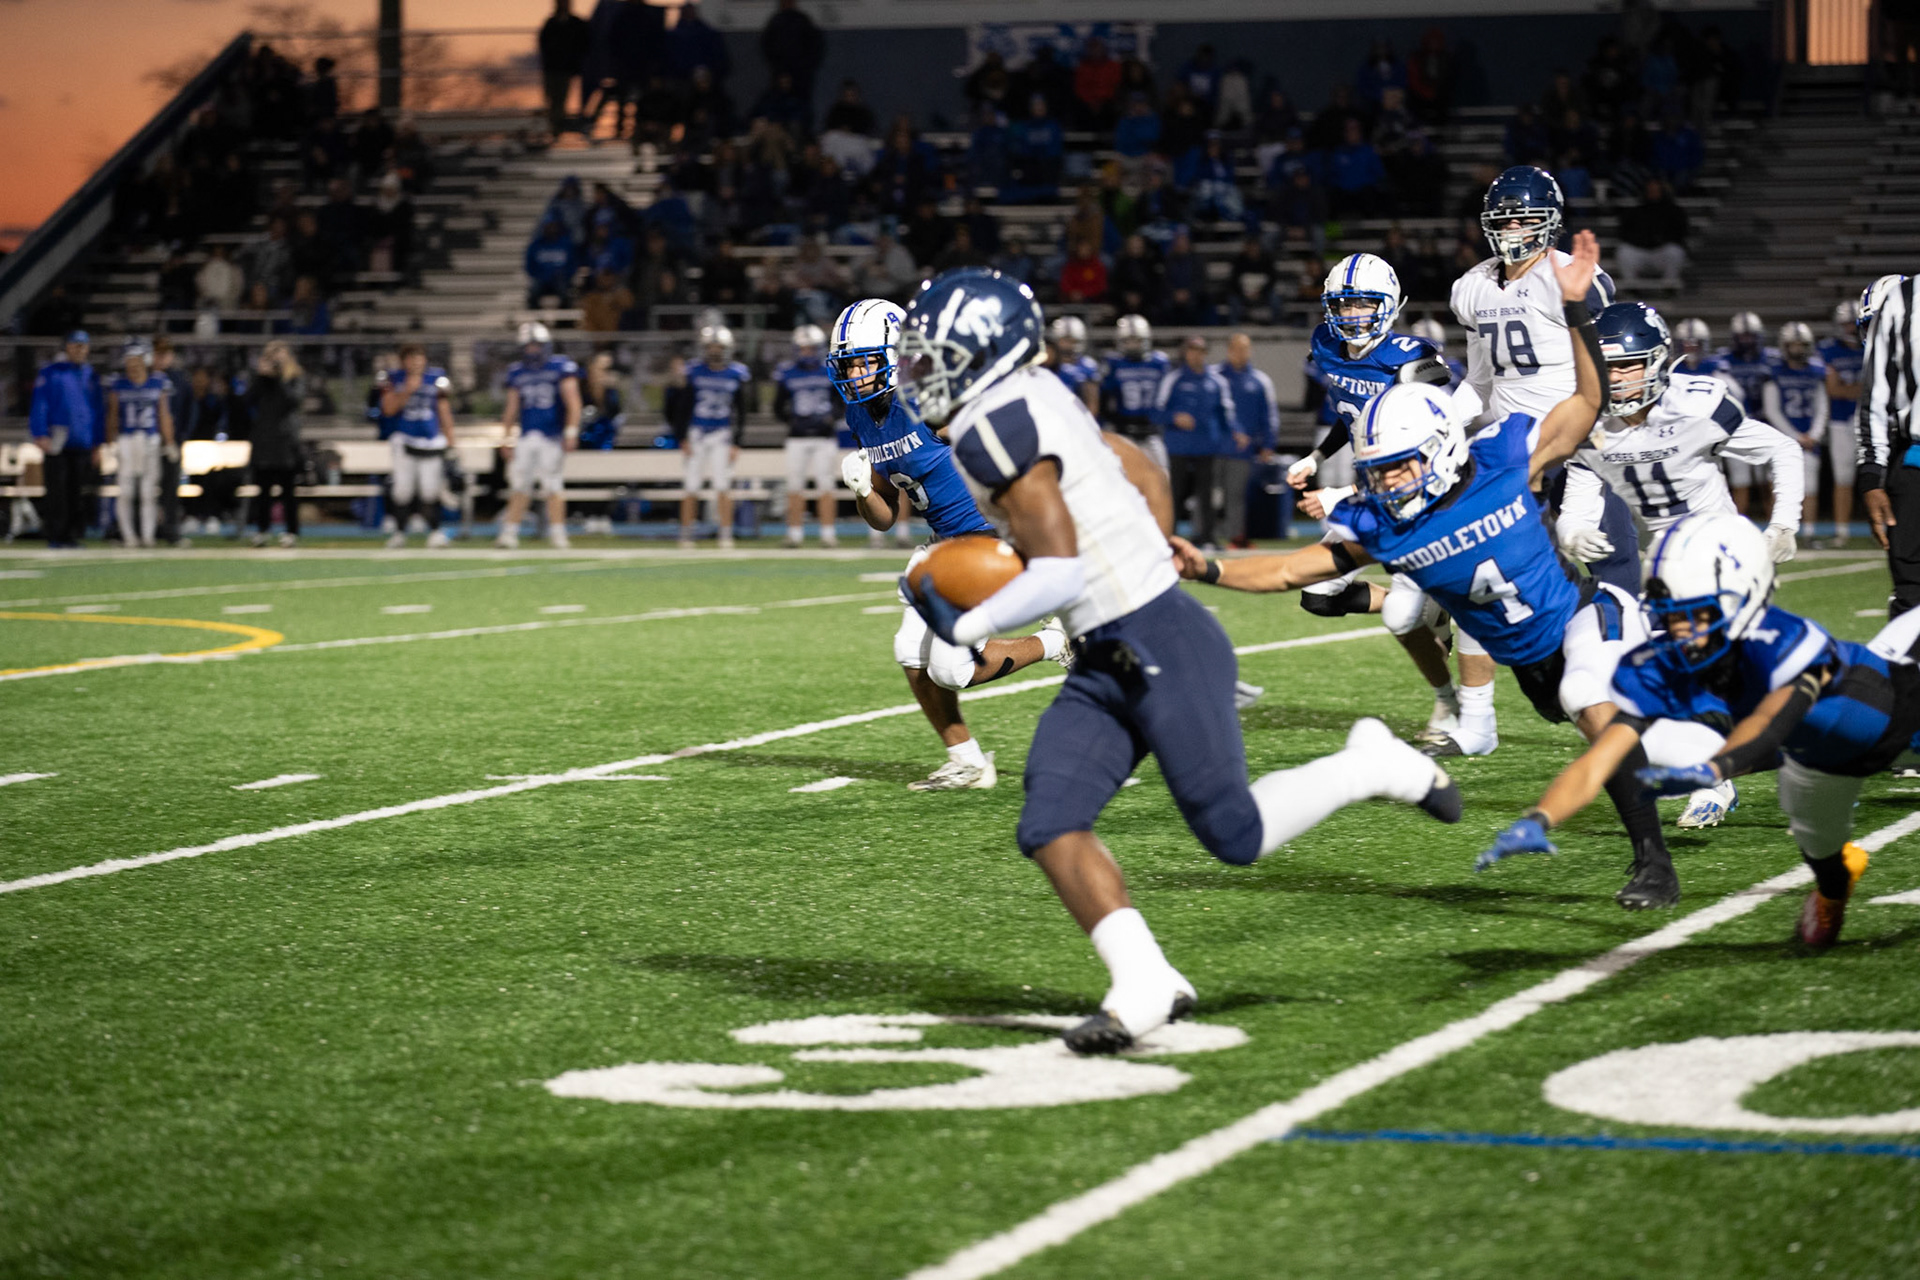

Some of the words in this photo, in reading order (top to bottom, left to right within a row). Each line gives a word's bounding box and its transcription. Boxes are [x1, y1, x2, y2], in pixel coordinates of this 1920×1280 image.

[1475, 309, 1498, 319] MOSES
[1500, 306, 1527, 317] BROWN
[1391, 336, 1421, 353] 2
[1478, 320, 1541, 377] 78
[1424, 397, 1447, 420] 4
[1601, 452, 1635, 463] MOSES
[1639, 445, 1679, 461] BROWN
[1623, 461, 1690, 517] 11
[1389, 494, 1528, 571] MIDDLETOWN
[1469, 557, 1535, 625] 4
[545, 1013, 1250, 1111] 3
